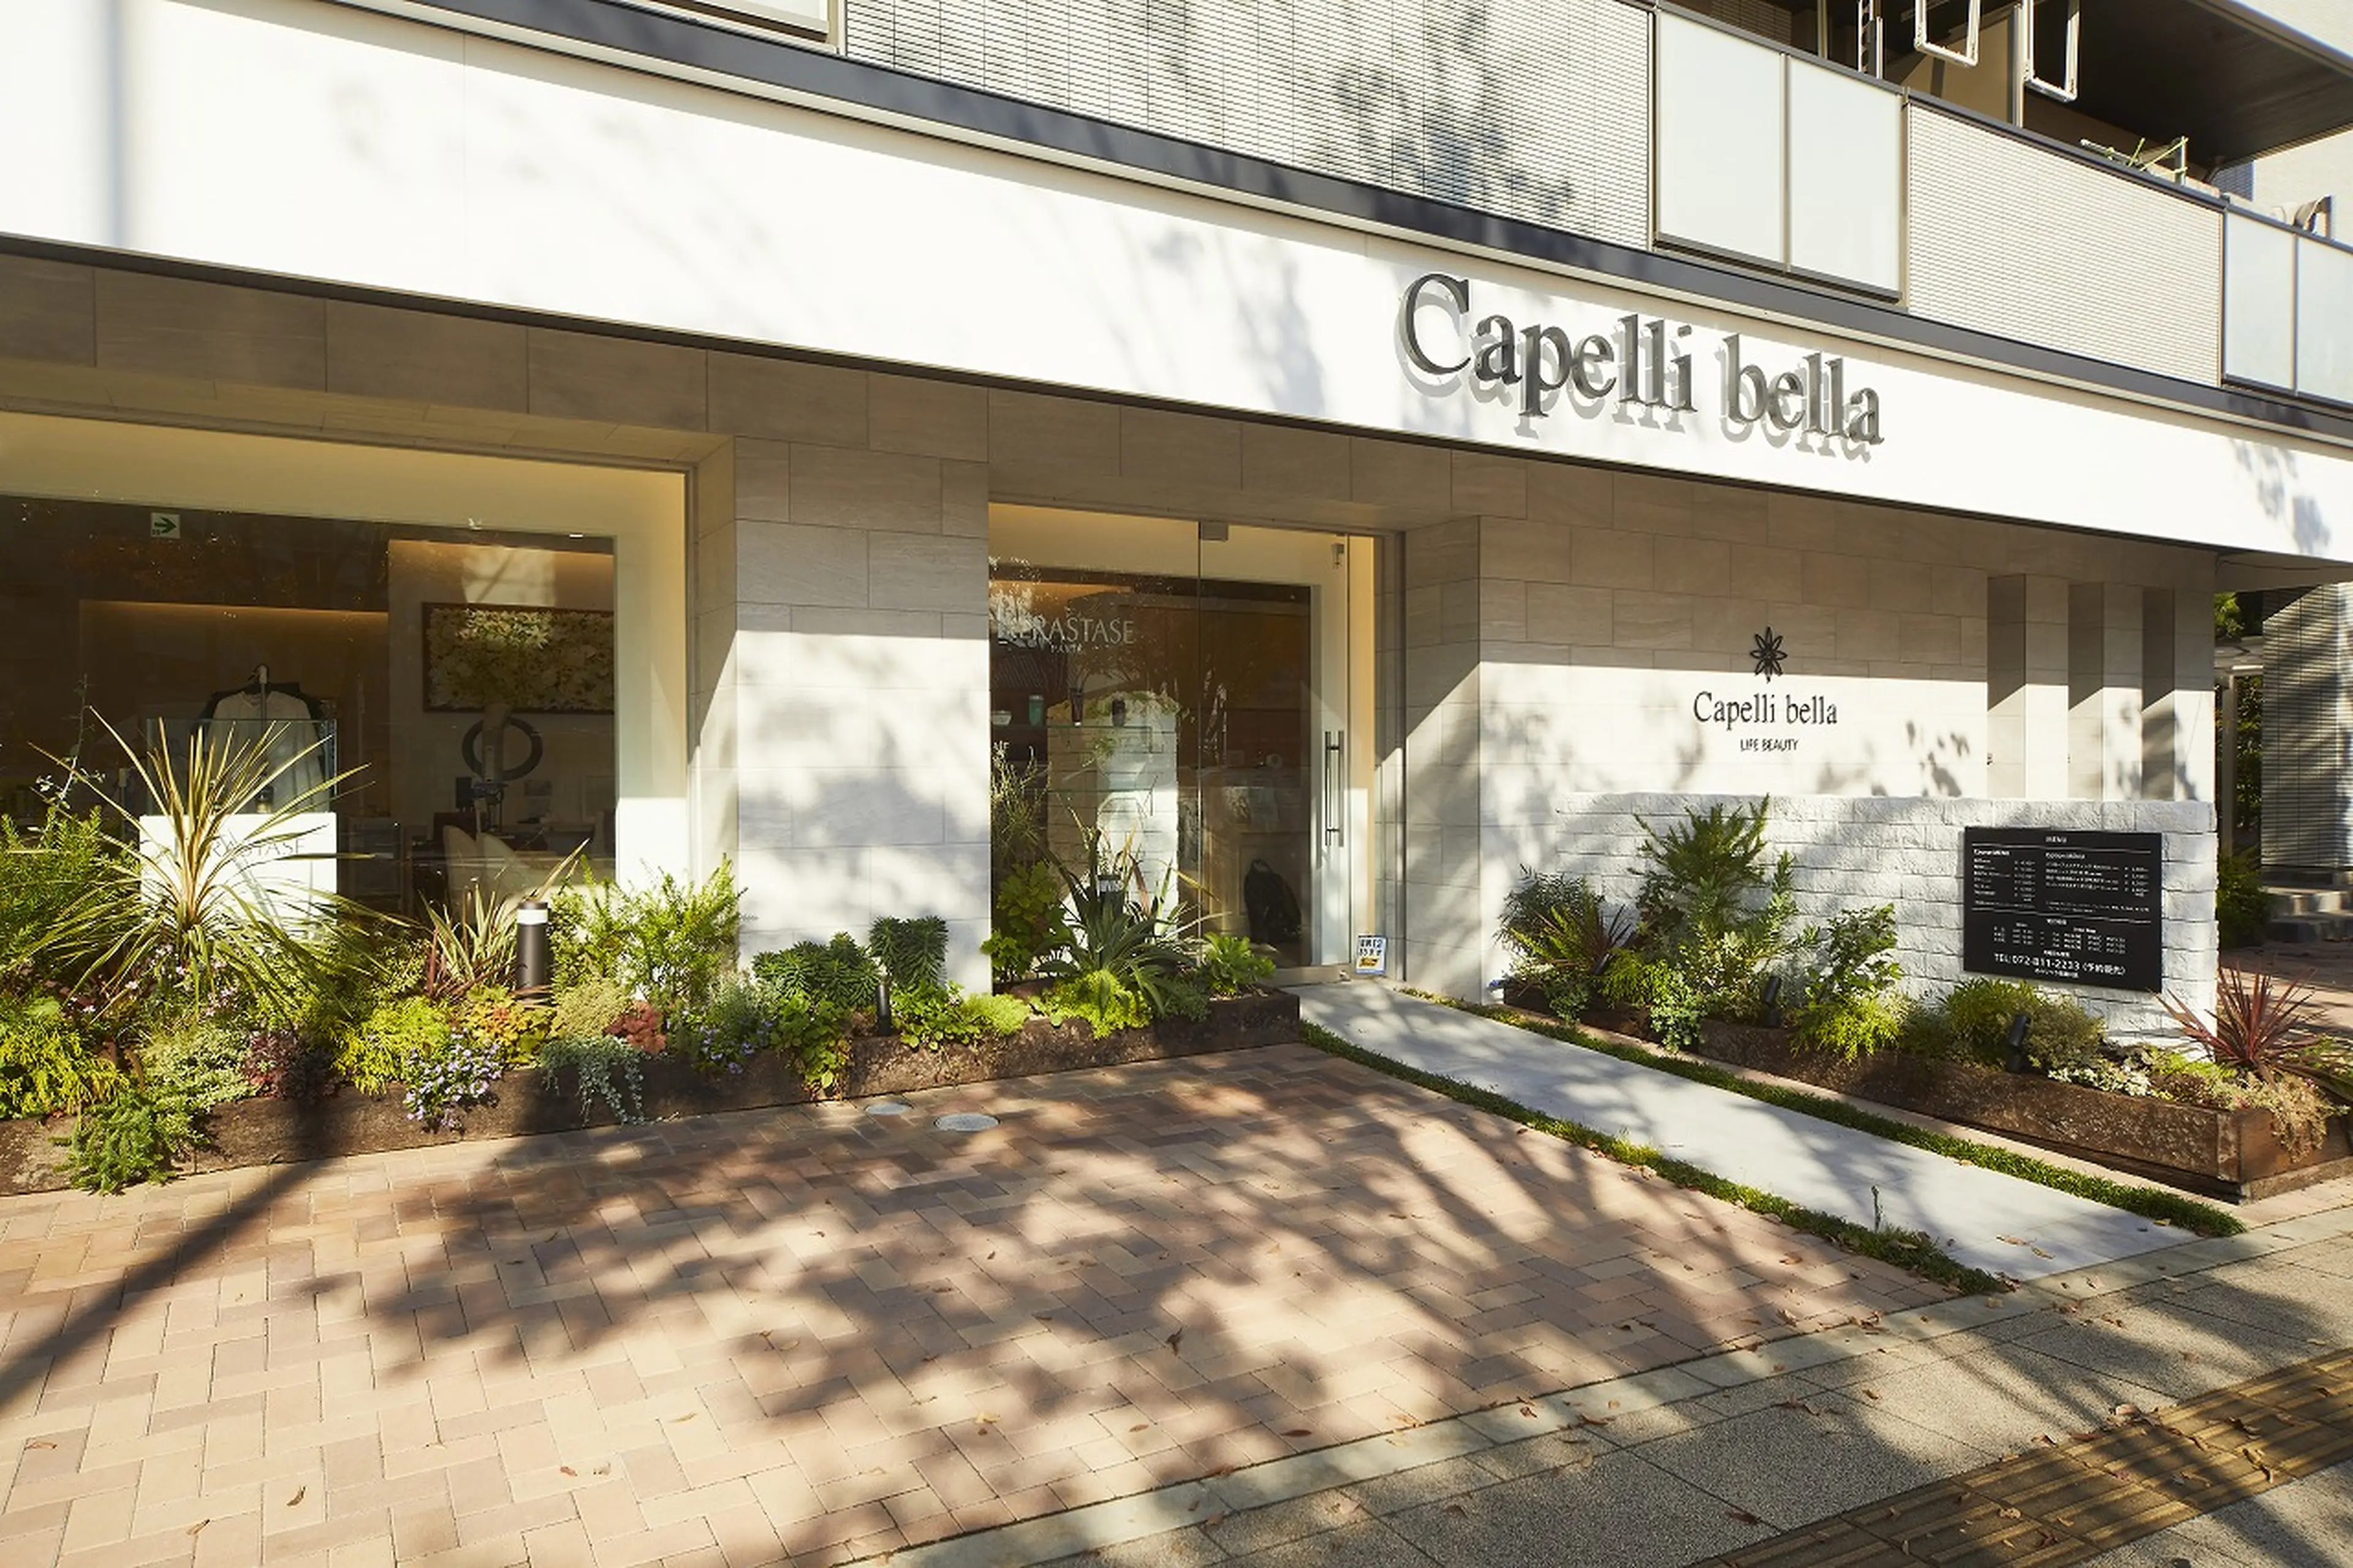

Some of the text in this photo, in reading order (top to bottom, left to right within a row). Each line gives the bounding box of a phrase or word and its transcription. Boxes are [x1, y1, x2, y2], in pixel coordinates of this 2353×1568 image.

[1403, 273, 1885, 445] Capelli bella
[1693, 691, 1838, 732] Capelli bella
[1740, 738, 1799, 752] LIFE BEAUTY
